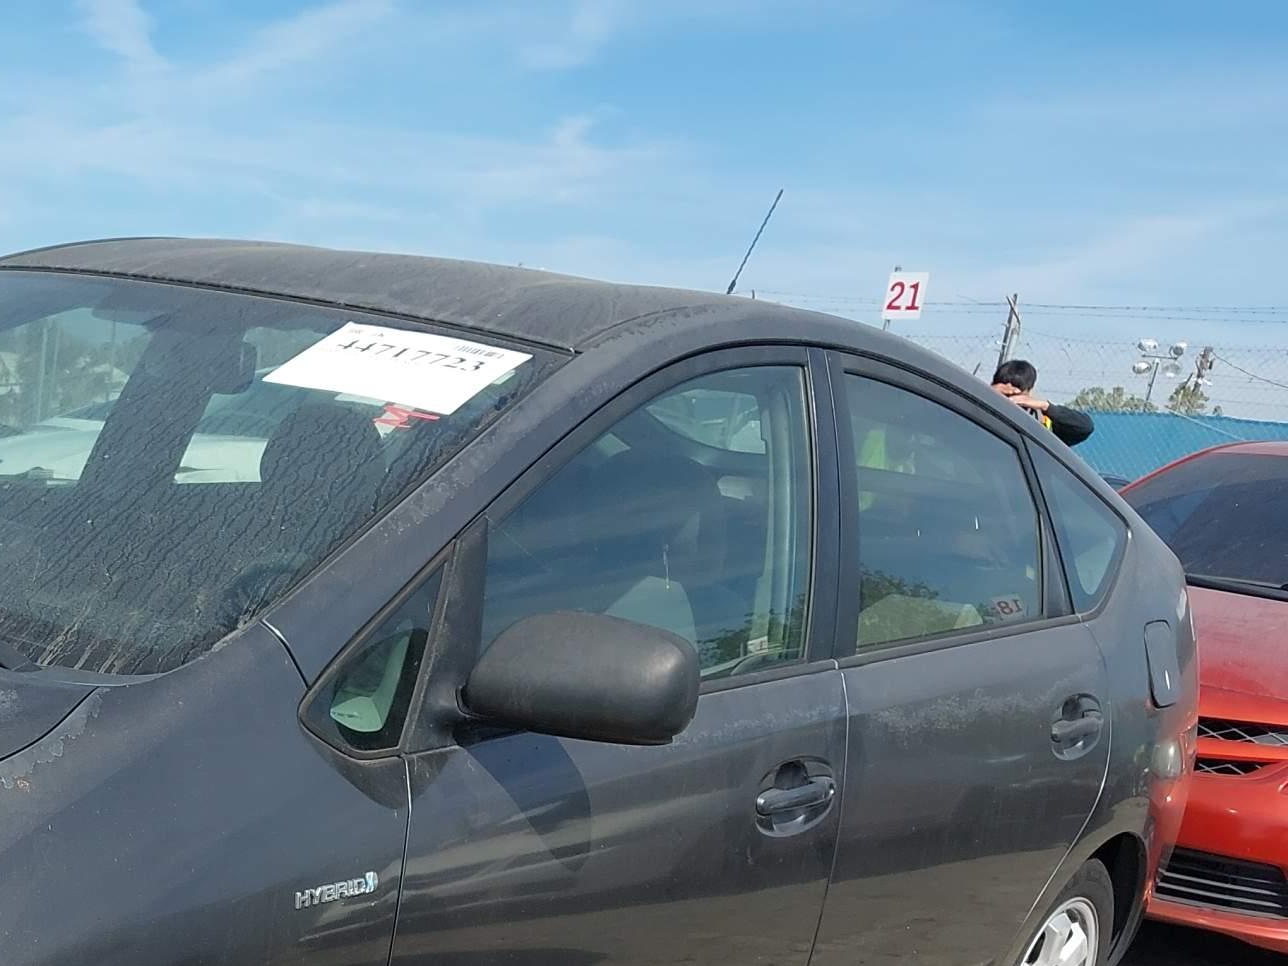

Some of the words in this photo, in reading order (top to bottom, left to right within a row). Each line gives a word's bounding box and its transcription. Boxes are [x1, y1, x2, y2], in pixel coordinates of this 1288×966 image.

[886, 281, 921, 310] 21
[337, 339, 486, 372] 44717723
[295, 877, 367, 909] HYBRID
